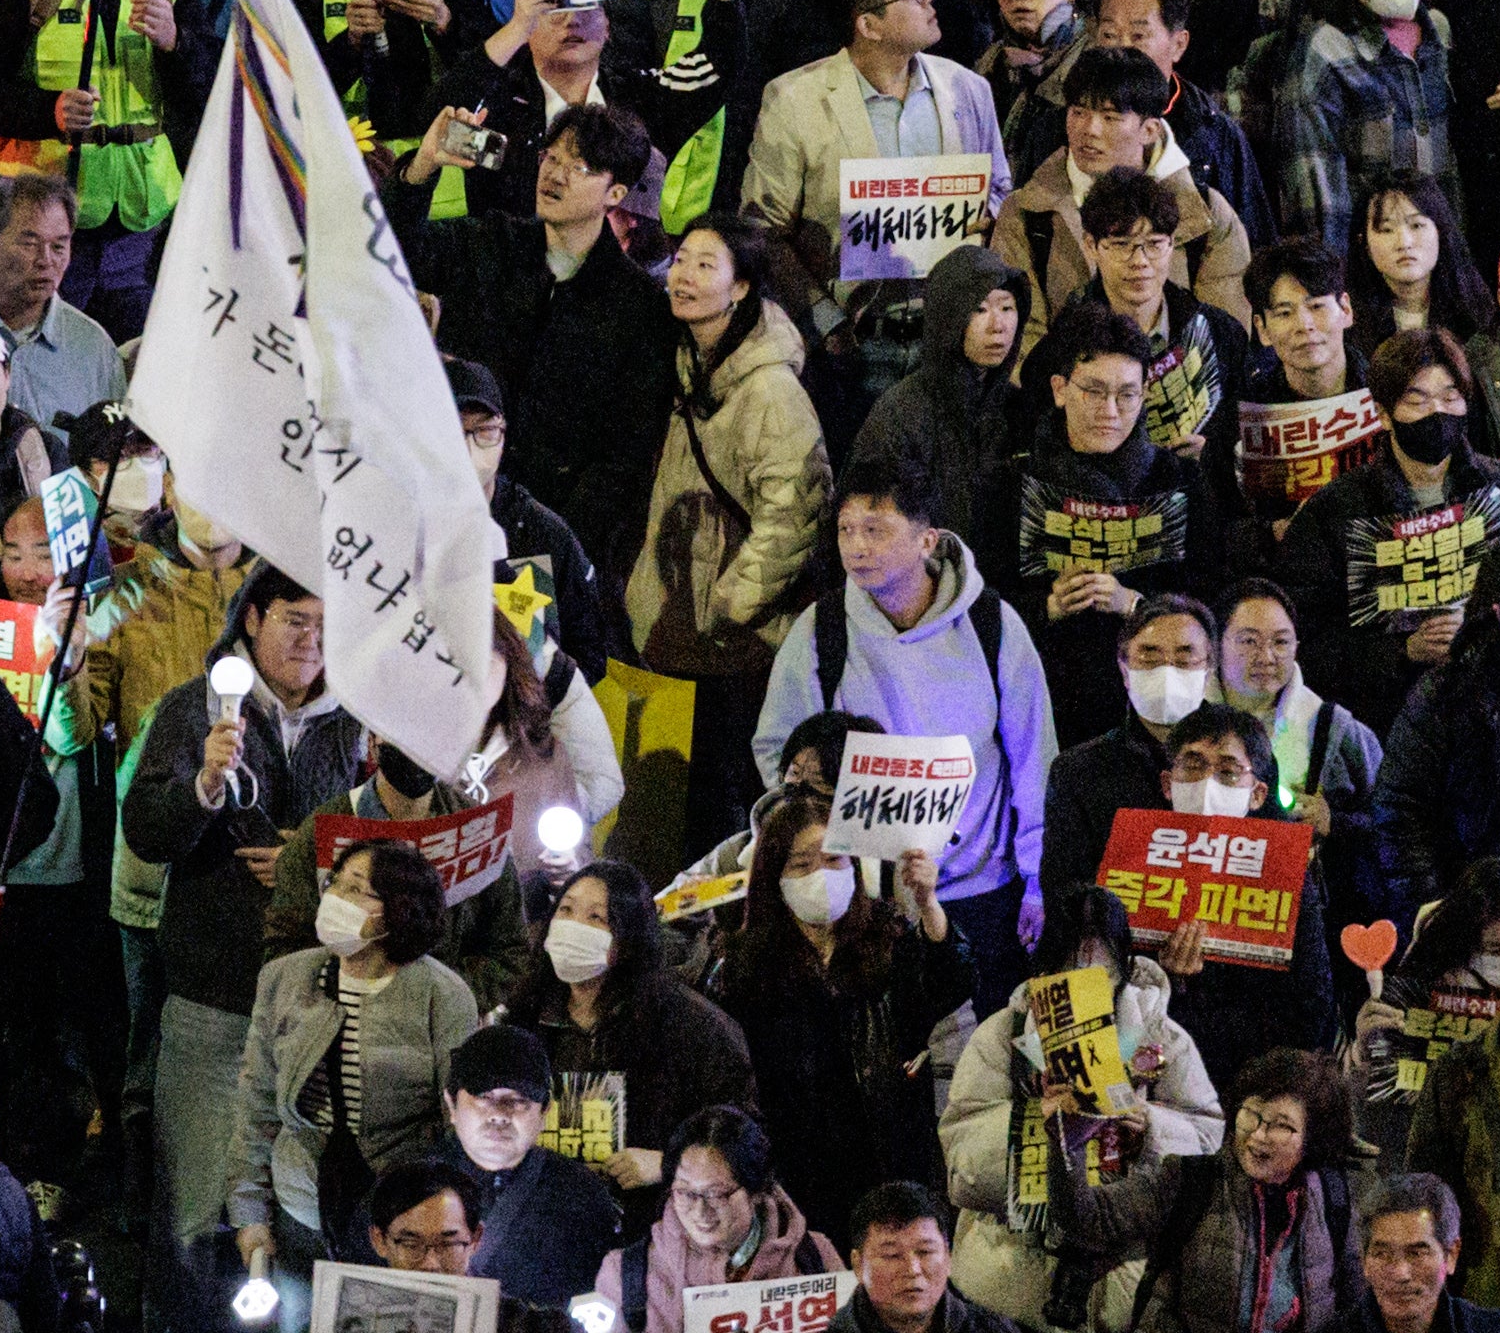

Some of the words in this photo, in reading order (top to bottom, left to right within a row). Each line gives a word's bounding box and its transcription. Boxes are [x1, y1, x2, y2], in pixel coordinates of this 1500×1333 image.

[849, 175, 922, 201] 내란동조
[845, 202, 988, 251] 해체하라!
[851, 753, 924, 780] 내란동조
[840, 785, 959, 831] 해체하라!
[1146, 828, 1267, 877] 윤석열
[1106, 869, 1188, 918] 즉각
[1198, 879, 1291, 935] 파면!
